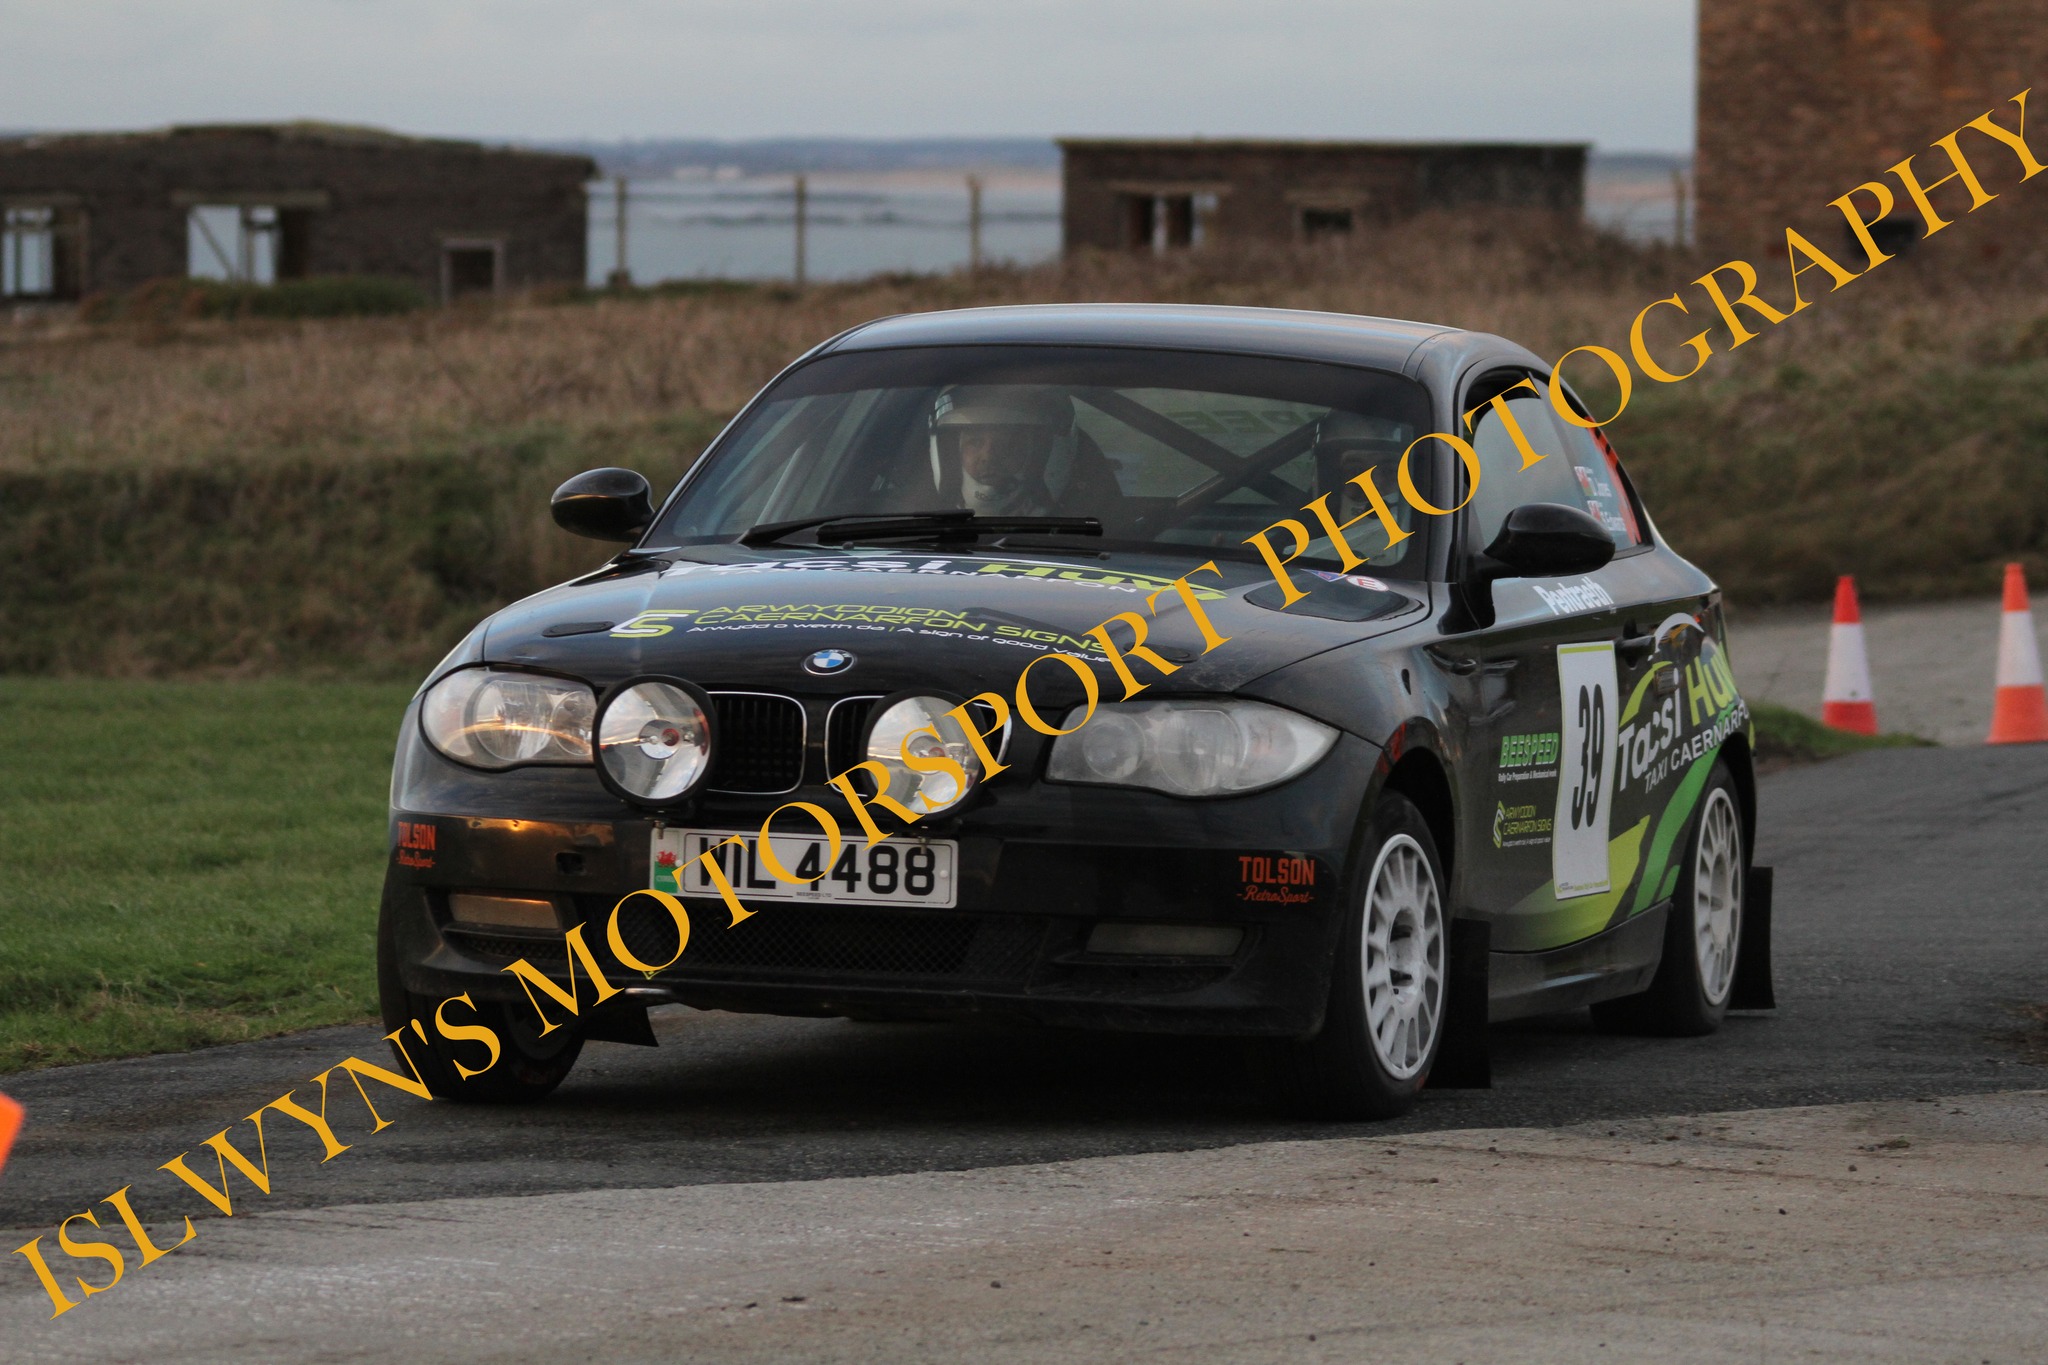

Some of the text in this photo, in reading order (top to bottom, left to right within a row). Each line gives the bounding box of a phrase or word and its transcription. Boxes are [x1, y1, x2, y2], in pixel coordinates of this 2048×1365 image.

[702, 604, 968, 620] ARWYDDION
[1532, 575, 1615, 615] Pentraeth
[685, 623, 771, 633] Arwydd
[918, 629, 964, 637] sign
[967, 633, 989, 641] of
[992, 638, 1048, 651] good
[694, 612, 1108, 654] CAERNARFON SIGNS
[1499, 733, 1559, 768] BEESPEED
[1571, 684, 1605, 830] 39
[1645, 756, 1668, 794] TAXI
[795, 842, 935, 896] 4488
[1238, 856, 1315, 885] TOLSON
